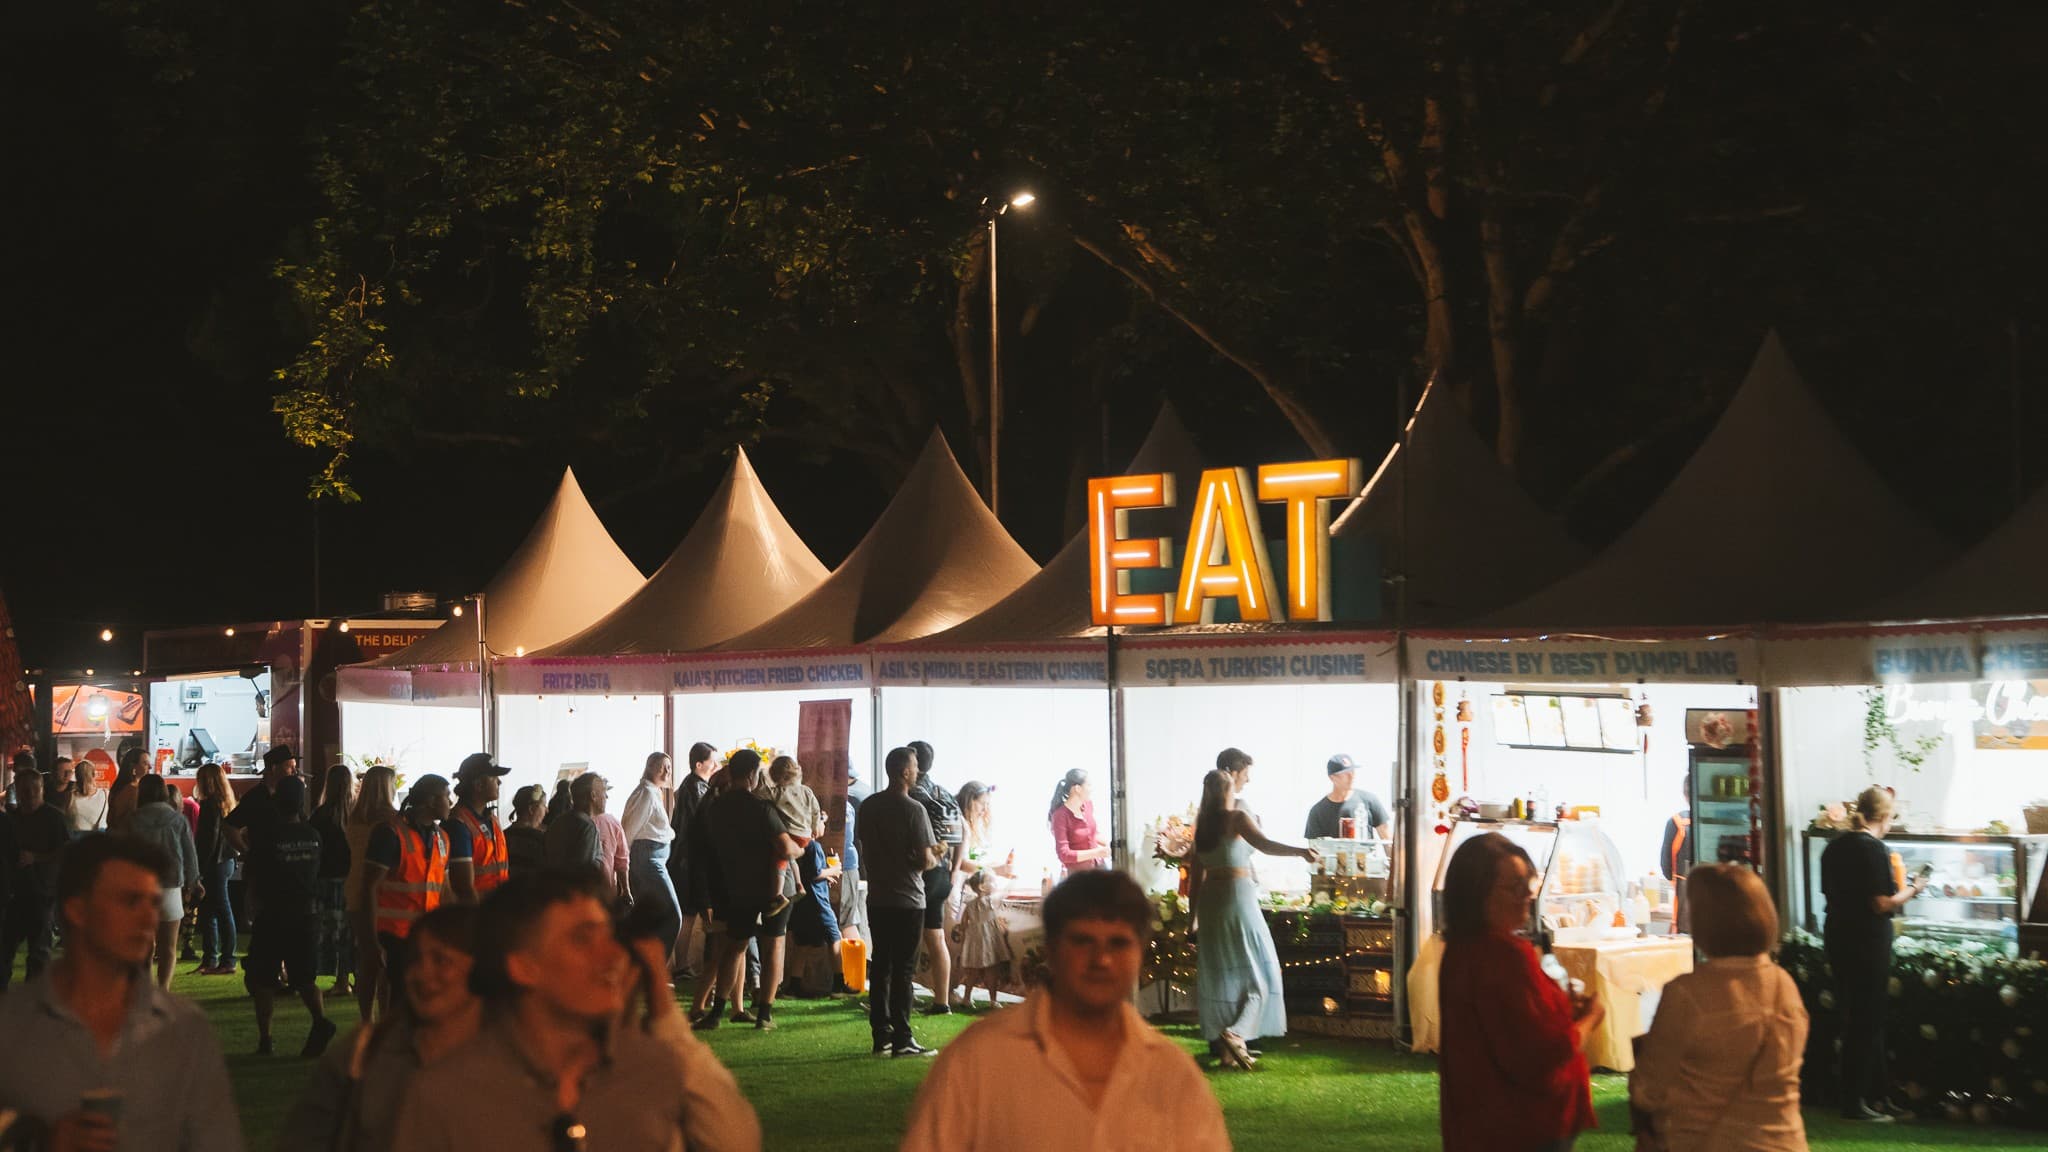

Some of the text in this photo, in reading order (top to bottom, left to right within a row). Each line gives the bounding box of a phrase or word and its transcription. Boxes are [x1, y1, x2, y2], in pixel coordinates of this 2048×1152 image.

[1088, 458, 1361, 626] EAT
[355, 635, 426, 646] THE DELI
[879, 661, 1106, 681] ASIL'S MIDDLE EASTERN CUISINE
[1145, 654, 1366, 679] SOFRA TURKISH CUISINE
[1426, 650, 1738, 676] CHINESE BY BEST DUMPLING
[1875, 648, 1970, 673] BUNYA
[543, 672, 611, 689] FRITZ PASTA
[674, 664, 864, 687] KAIA'S KITCHEN FRIED CHICKEN
